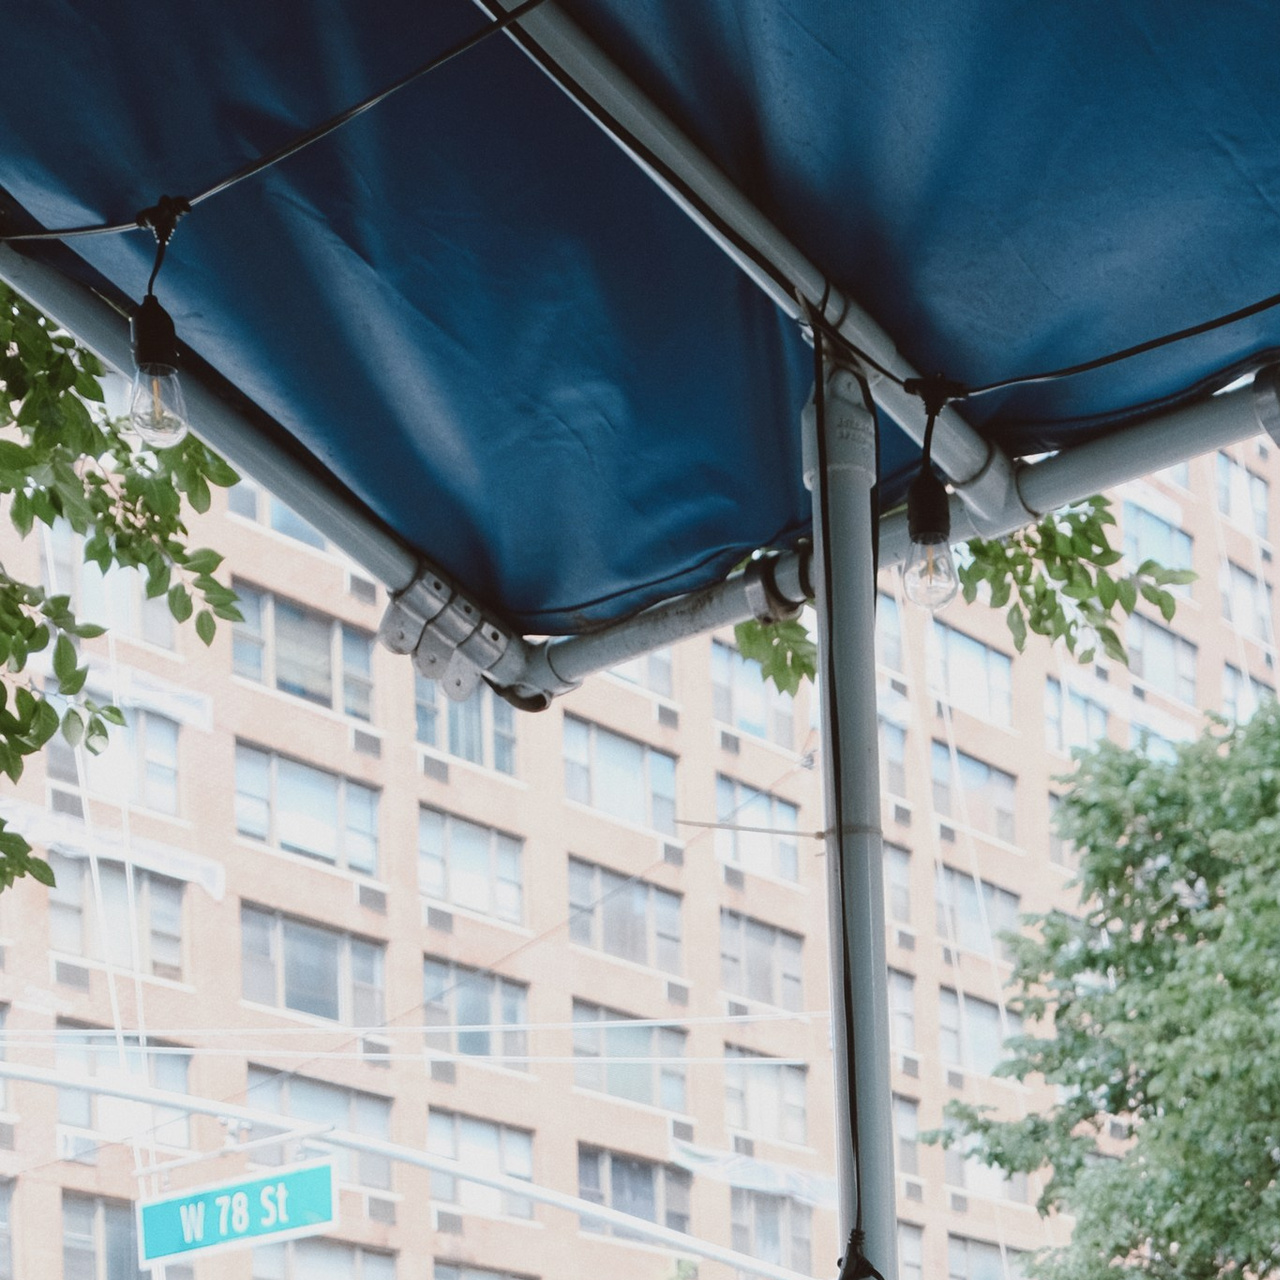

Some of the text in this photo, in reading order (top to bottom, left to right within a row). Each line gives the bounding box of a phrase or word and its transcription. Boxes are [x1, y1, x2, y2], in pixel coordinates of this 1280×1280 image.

[180, 1181, 289, 1244] W 78 St
